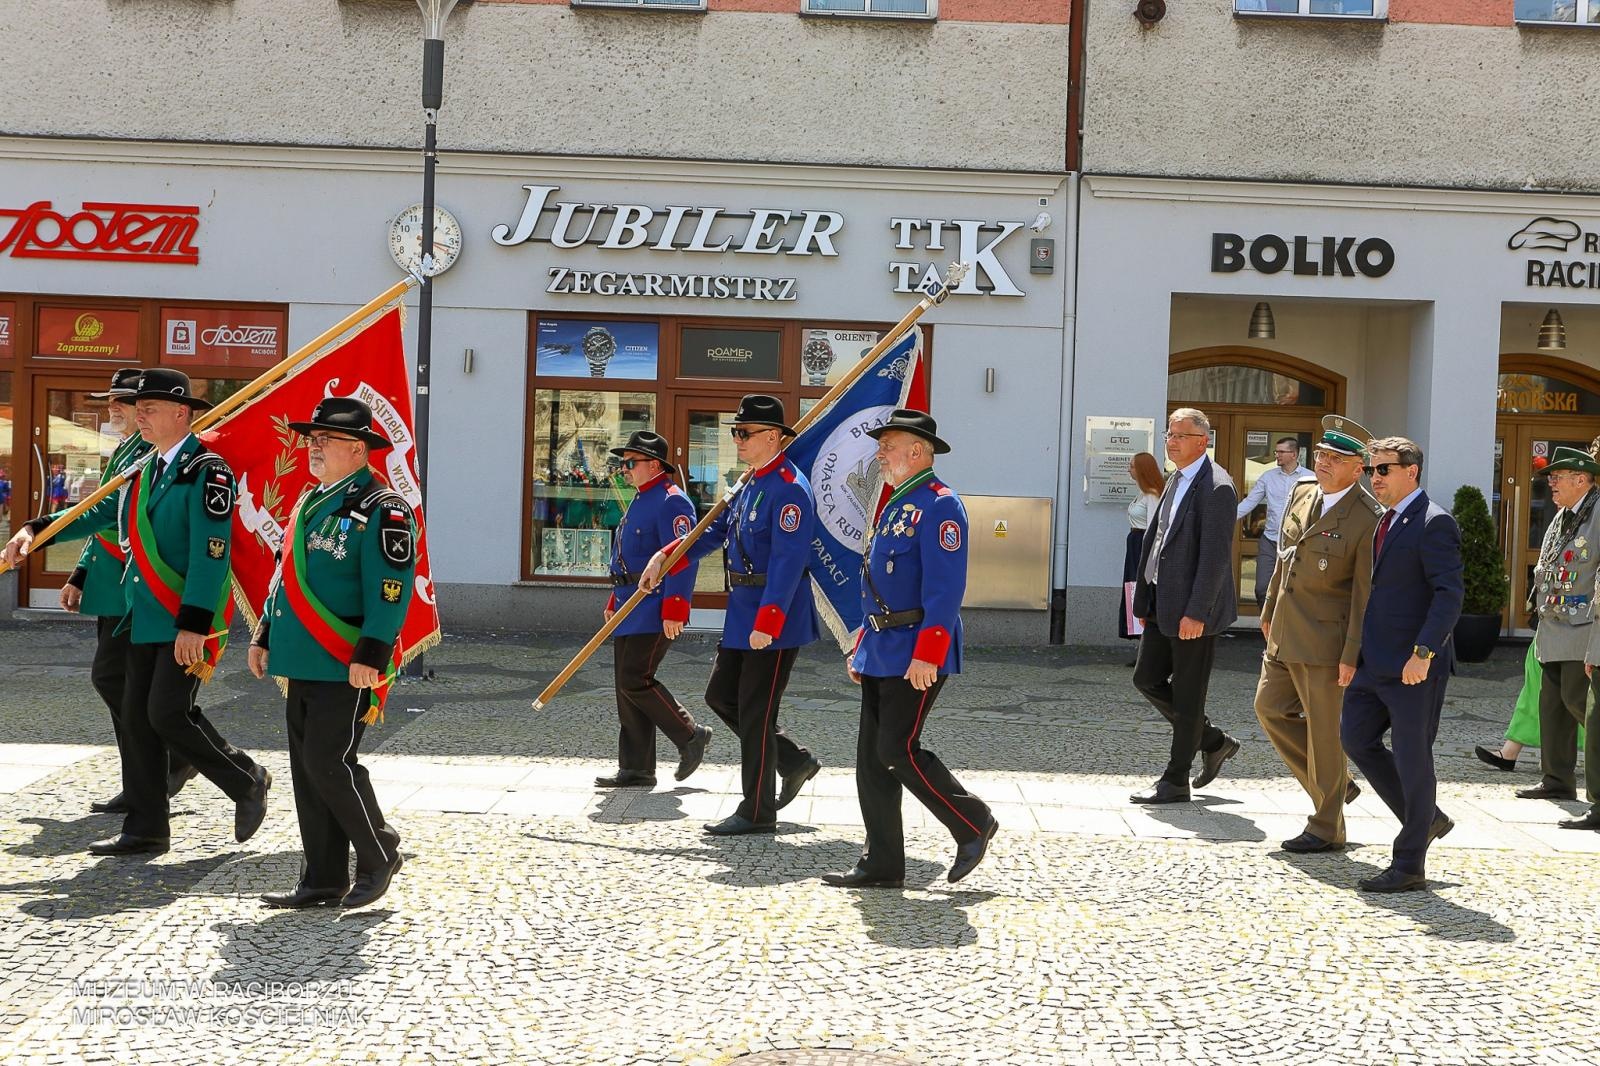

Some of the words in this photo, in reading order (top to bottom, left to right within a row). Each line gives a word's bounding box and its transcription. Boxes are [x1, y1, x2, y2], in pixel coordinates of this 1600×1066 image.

[490, 184, 845, 257] JUBILER
[1211, 232, 1395, 278] BOLKO
[545, 266, 799, 301] ZEGARMISTRZ
[1527, 259, 1600, 289] RACI
[57, 342, 114, 355] Zapraszamy
[834, 332, 872, 342] ORIENT
[707, 347, 753, 359] ROAMER
[850, 418, 889, 439] BRA
